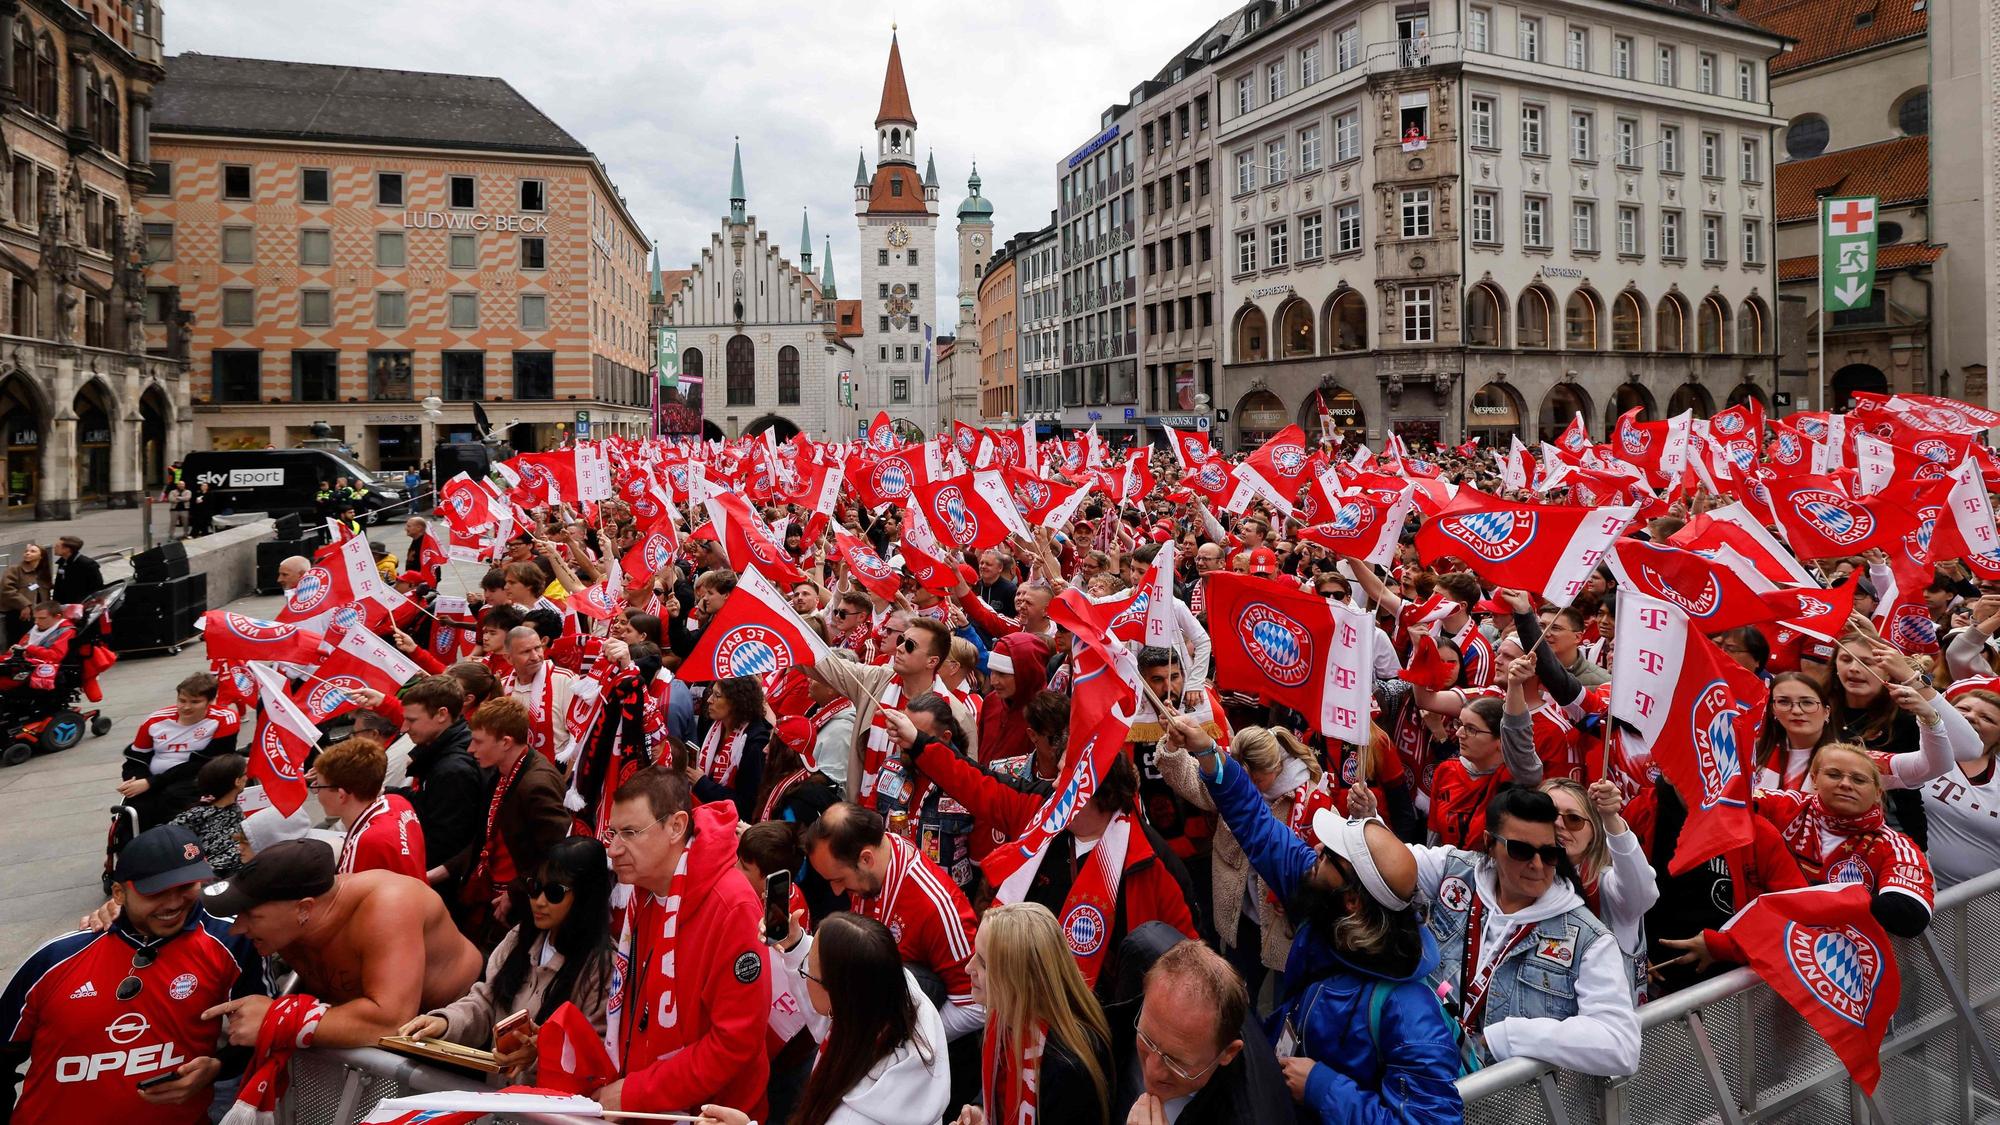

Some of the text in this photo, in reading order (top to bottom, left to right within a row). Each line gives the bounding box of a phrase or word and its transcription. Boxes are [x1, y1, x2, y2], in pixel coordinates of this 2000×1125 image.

[404, 211, 548, 232] LUDWIG BECK
[1541, 265, 1581, 278] NESPRESSO
[1250, 284, 1290, 299] NESPRESSO
[578, 412, 587, 421] S
[1474, 406, 1507, 415] NESPRESSO
[579, 424, 586, 432] U
[860, 420, 867, 428] S
[1160, 417, 1193, 425] SWAROVSKI
[860, 430, 867, 438] U
[1870, 445, 1882, 456] T
[1871, 464, 1884, 474] T
[1920, 468, 1931, 479] FC
[197, 471, 281, 487] sky sport
[1871, 484, 1881, 495] T
[1795, 493, 1852, 509] BAYERN
[1964, 498, 1980, 513] T
[1602, 516, 1625, 535] T
[1812, 515, 1869, 542] MÜNCHEN
[1975, 526, 1989, 541] T
[1582, 550, 1601, 566] T
[1565, 580, 1583, 596] T
[1909, 606, 1925, 616] FC
[1640, 608, 1668, 631] T
[1342, 623, 1357, 648] T
[1639, 649, 1664, 676] T
[1336, 667, 1356, 689] T
[1634, 690, 1654, 718] T
[1705, 689, 1726, 714] FC
[1337, 706, 1357, 728] T
[1887, 876, 1925, 895] Allianz
[1072, 909, 1102, 932] FC BAYERN
[1066, 927, 1098, 952] MÜNCHEN
[70, 990, 97, 1000] adidas
[56, 1041, 185, 1083] OPEL
